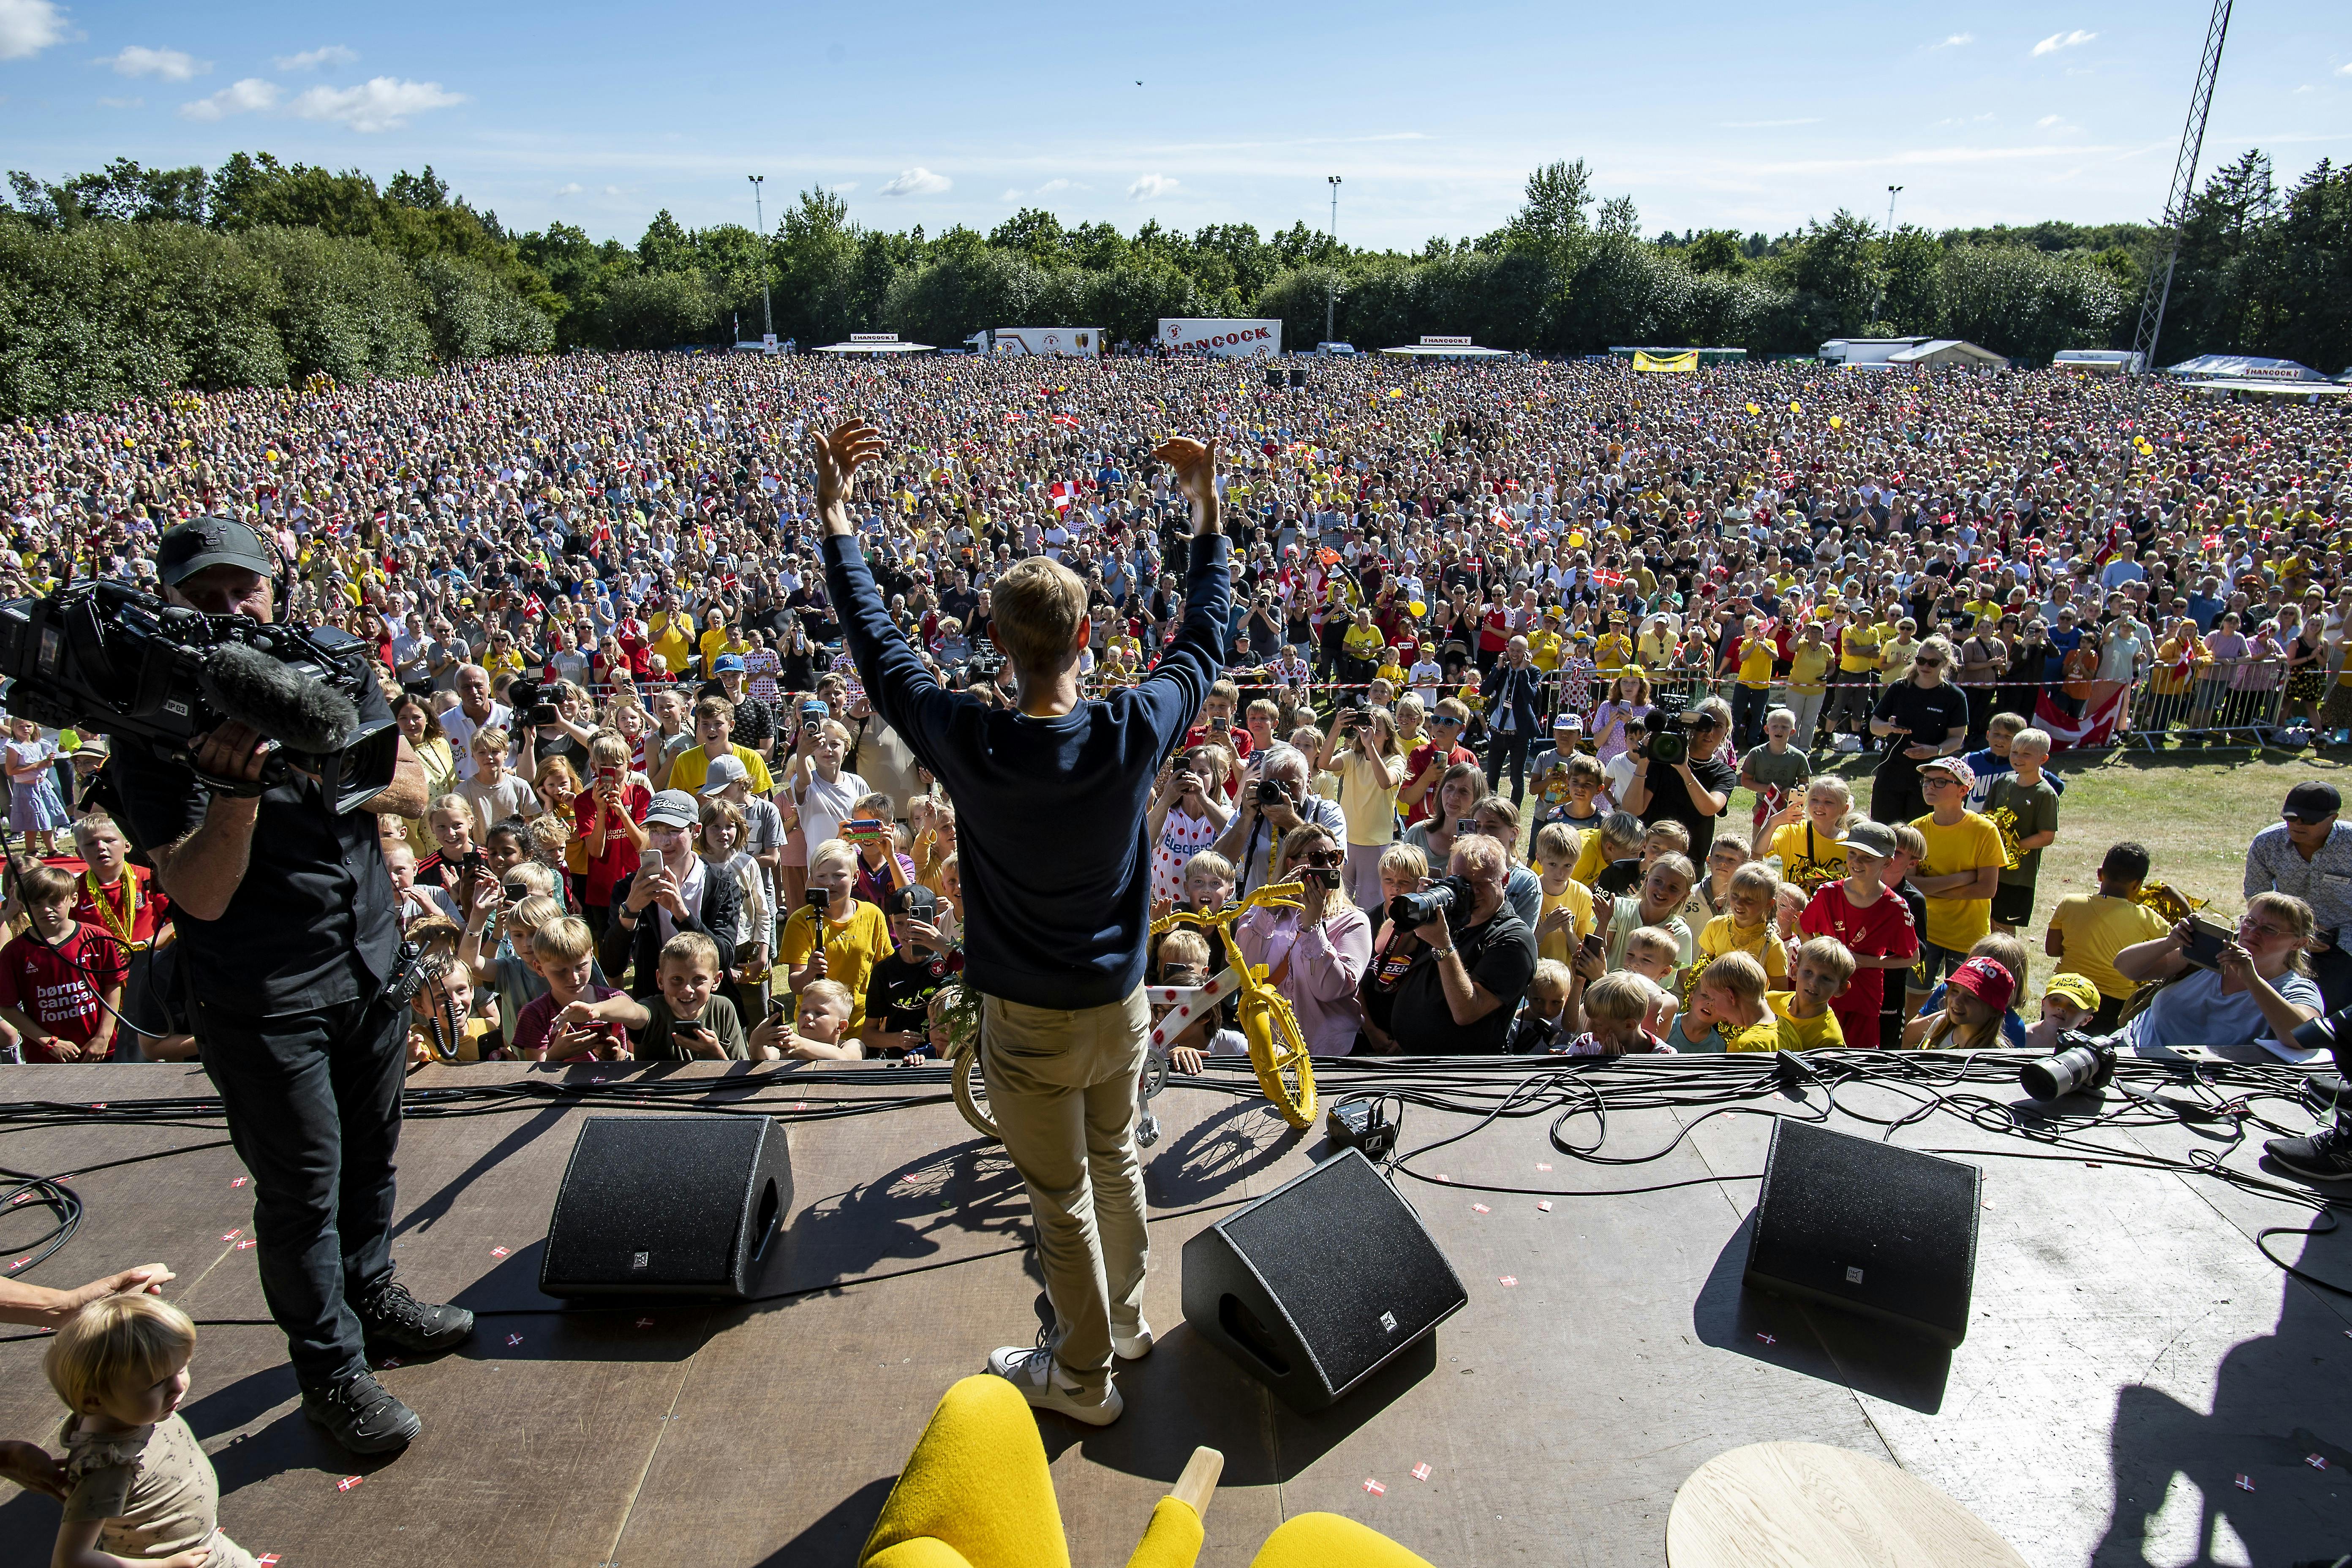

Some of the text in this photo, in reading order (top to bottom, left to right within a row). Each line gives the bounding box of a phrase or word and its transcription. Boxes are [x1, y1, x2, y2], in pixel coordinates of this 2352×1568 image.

[1167, 327, 1271, 357] HANCOCK
[176, 705, 185, 713] 03
[647, 798, 686, 812] Titleist
[1386, 934, 1399, 954] Canon
[1966, 957, 1997, 979] dao
[36, 980, 86, 998] børne
[41, 1002, 97, 1022] fonden
